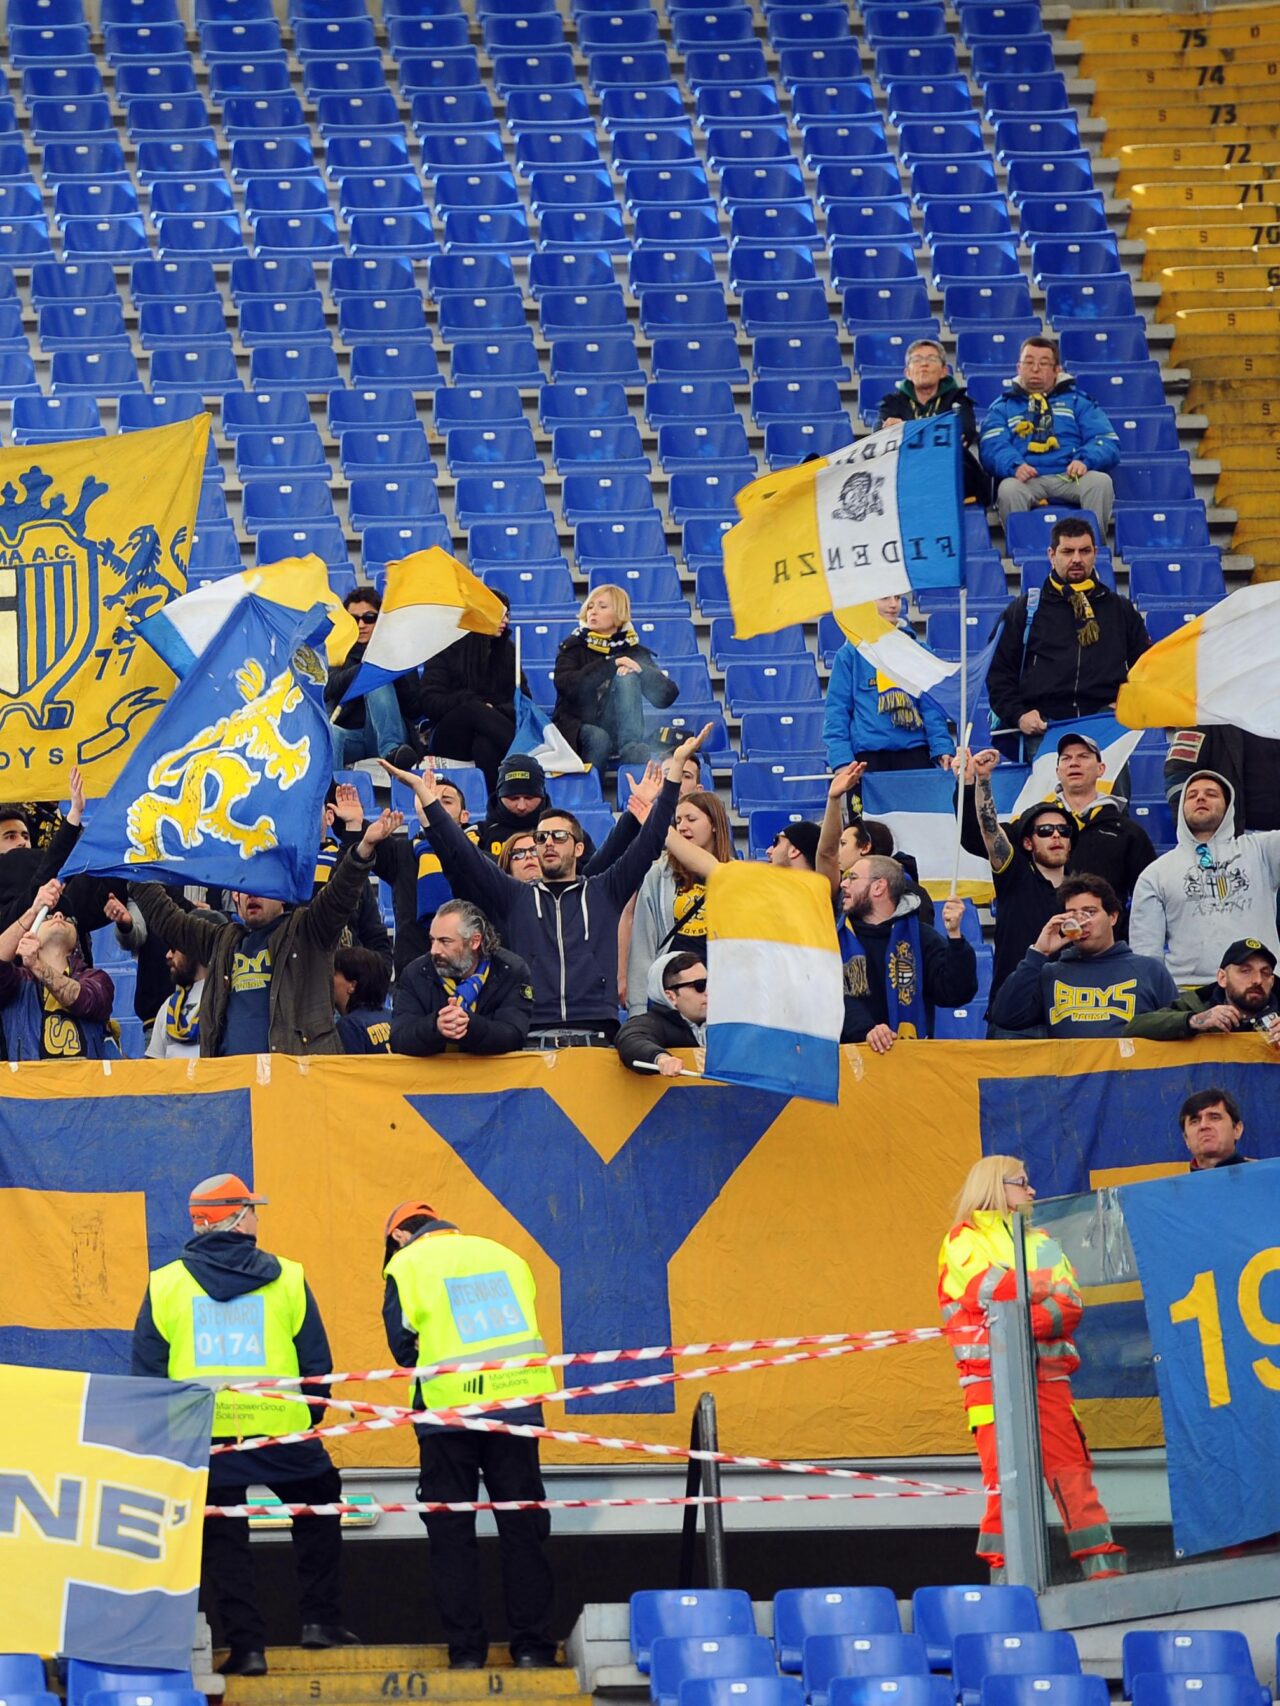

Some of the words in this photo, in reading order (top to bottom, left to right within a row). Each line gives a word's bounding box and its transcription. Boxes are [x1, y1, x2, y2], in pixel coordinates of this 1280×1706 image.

[1179, 29, 1208, 49] 75
[1196, 65, 1225, 85] 74
[1209, 104, 1237, 125] 73
[1222, 143, 1251, 164] 72
[1237, 184, 1264, 203] 71
[1250, 226, 1280, 246] 70
[1267, 266, 1280, 287] 6
[32, 543, 76, 564] A.C.
[94, 646, 136, 682] 77
[1051, 978, 1137, 1018] BOYS
[451, 1277, 509, 1307] STEWARD
[198, 1302, 258, 1326] STEWARD
[197, 1332, 260, 1356] 0174
[215, 1402, 286, 1412] ManpowerGroup
